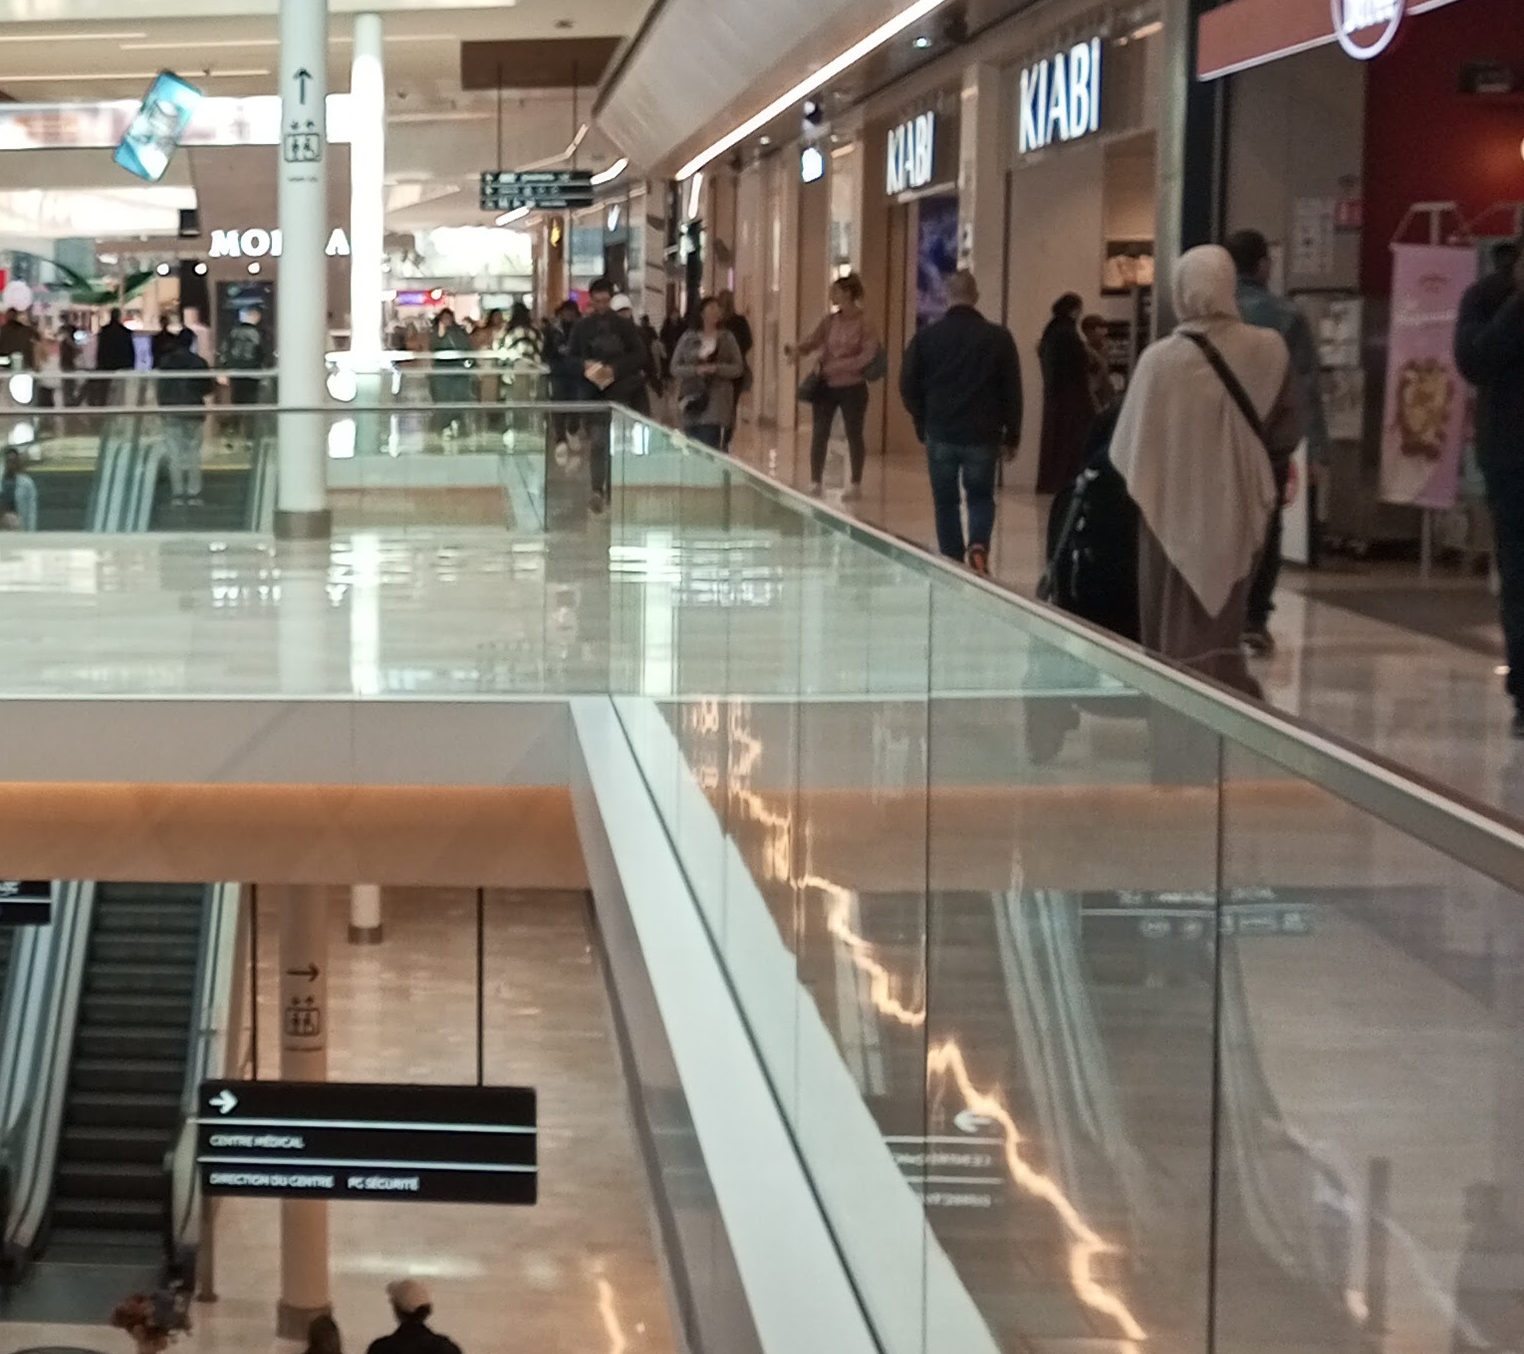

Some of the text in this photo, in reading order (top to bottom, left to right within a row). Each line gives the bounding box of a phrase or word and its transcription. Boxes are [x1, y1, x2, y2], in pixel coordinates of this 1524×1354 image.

[1019, 36, 1101, 154] KIABI
[886, 111, 935, 195] KIABI
[209, 1134, 306, 1149] CENTRE MÉDICAL
[209, 1172, 335, 1188] DIRECTION DU CENTRE
[348, 1176, 420, 1191] PC SÉCURITÉ
